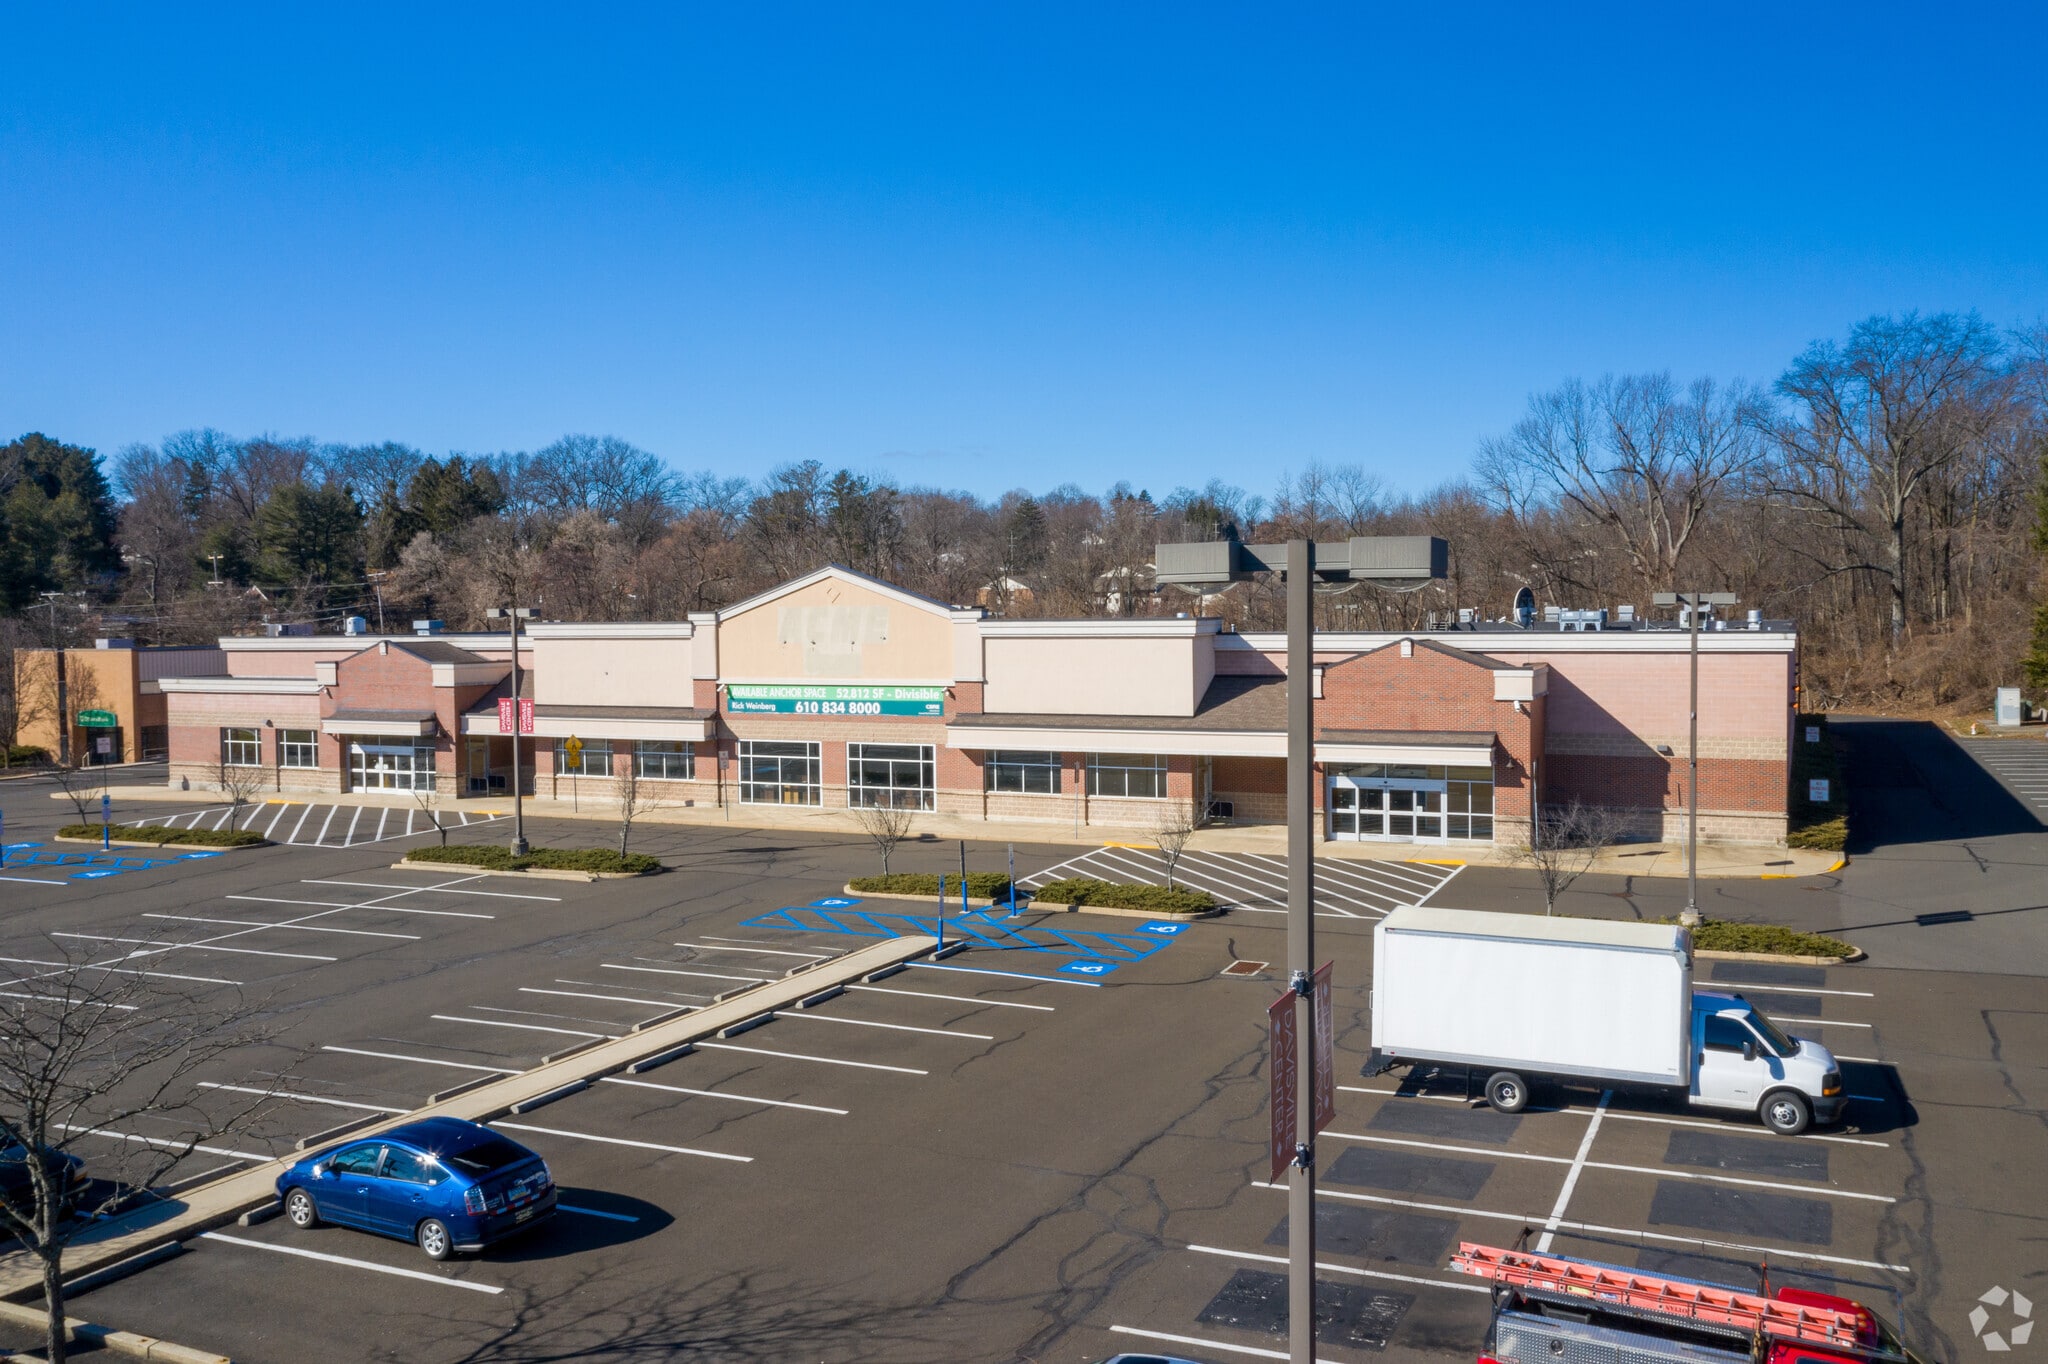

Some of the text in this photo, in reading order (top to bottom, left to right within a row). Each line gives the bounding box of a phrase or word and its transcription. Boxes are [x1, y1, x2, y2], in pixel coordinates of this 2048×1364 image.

[732, 688, 826, 698] AVAILABLE ANCHOR SPACE
[836, 688, 869, 699] 52,812
[872, 688, 884, 699] SF
[895, 689, 940, 699] Divisible
[746, 702, 776, 711] Weinberg
[795, 701, 881, 714] 610 834 8000
[1284, 1008, 1295, 1150] DAVISVILLE
[1274, 1040, 1284, 1137] CENTER
